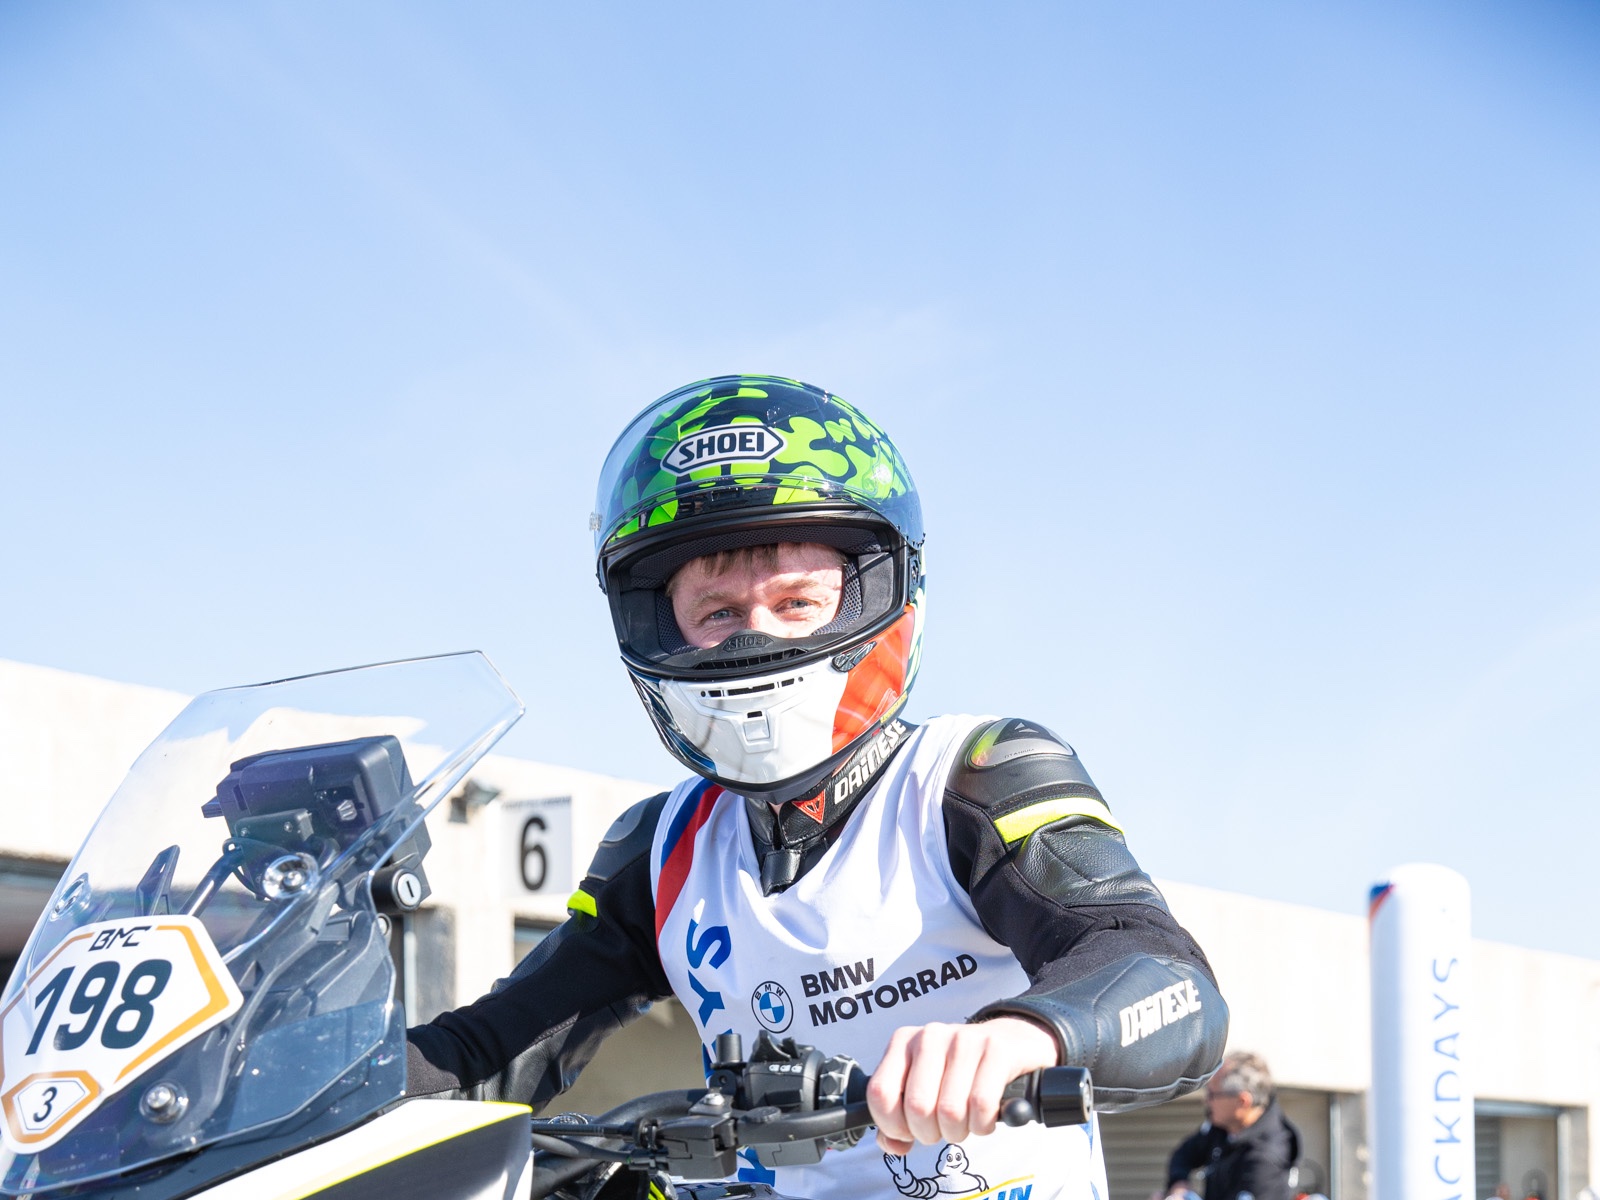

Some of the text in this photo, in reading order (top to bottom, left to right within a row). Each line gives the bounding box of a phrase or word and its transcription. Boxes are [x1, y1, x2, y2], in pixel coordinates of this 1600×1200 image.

[679, 432, 765, 466] SHOEI
[520, 816, 547, 890] 6
[88, 925, 152, 952] BMC
[754, 983, 784, 1001] BMW
[800, 958, 874, 998] BMW
[809, 953, 978, 1027] MOTORRAD
[25, 959, 172, 1056] 198
[33, 1086, 57, 1122] 3
